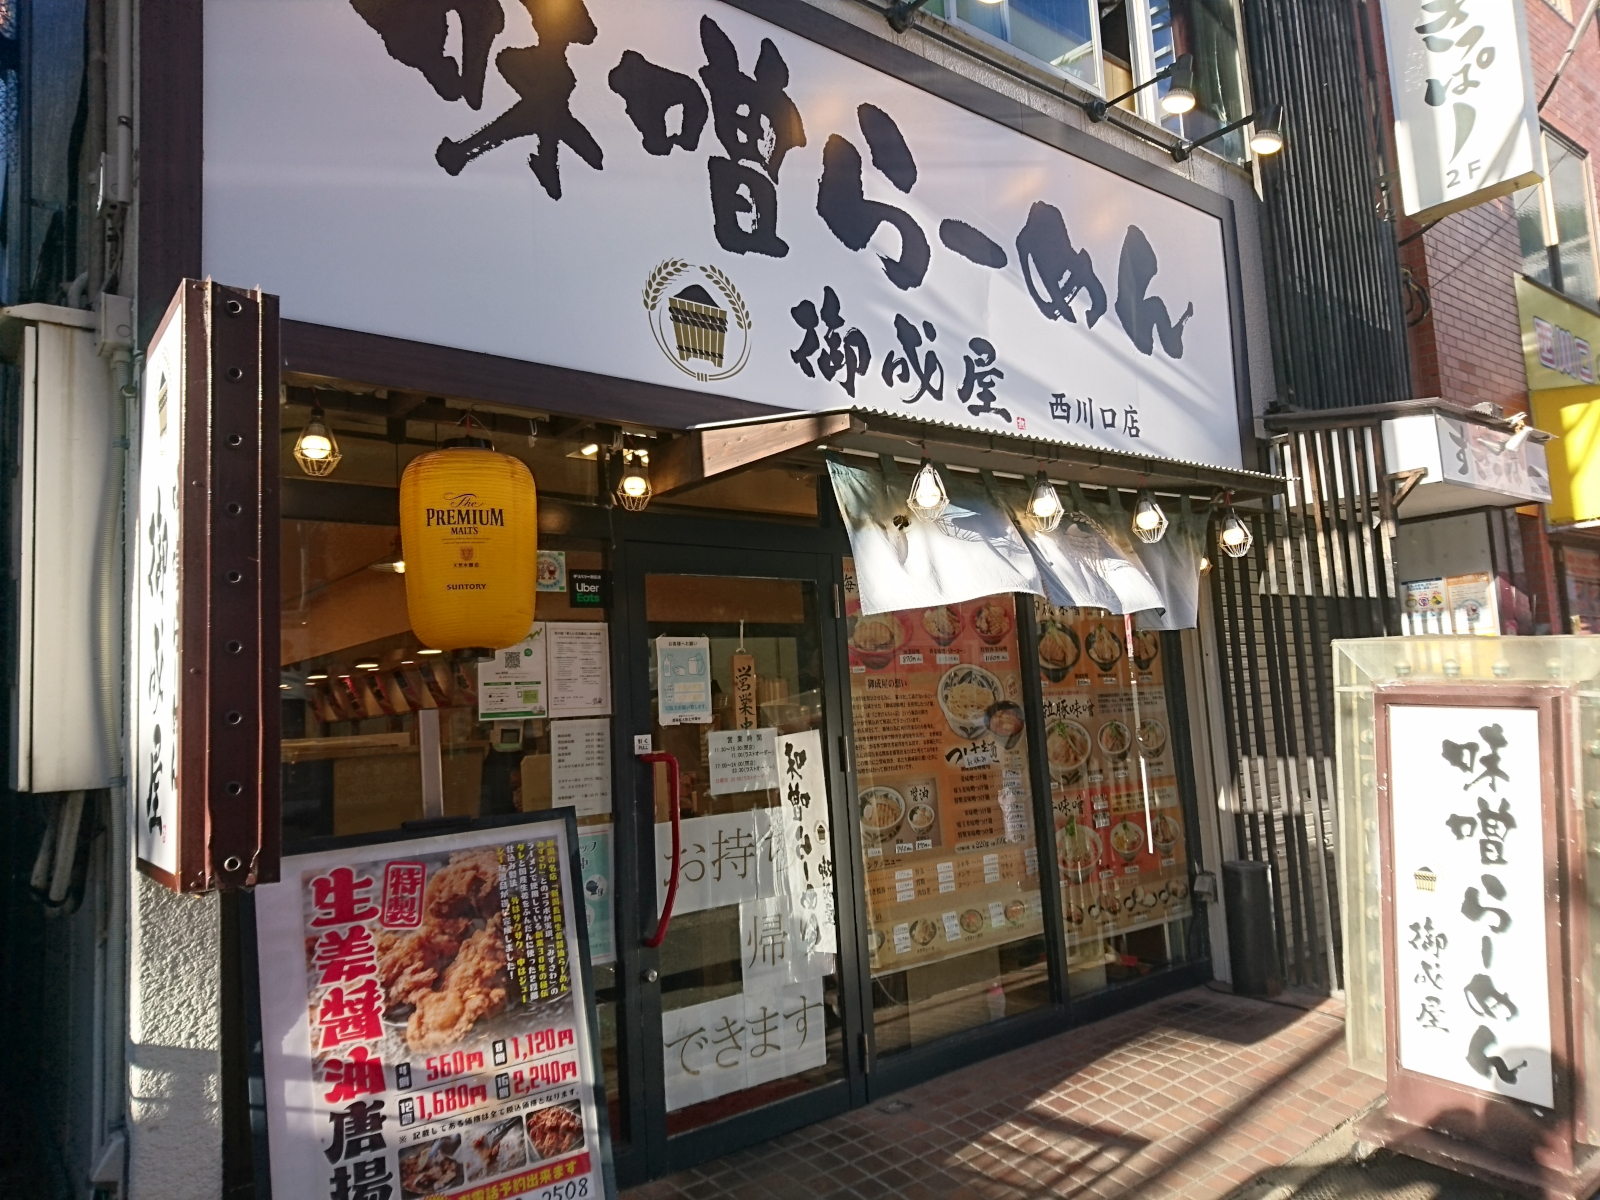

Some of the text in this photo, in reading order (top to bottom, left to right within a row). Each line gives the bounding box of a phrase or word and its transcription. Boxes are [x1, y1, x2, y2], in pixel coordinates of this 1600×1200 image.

[350, 0, 1193, 359] 味噌らーめん
[1446, 159, 1481, 188] 2F
[789, 285, 1012, 423] 御成屋
[1049, 393, 1141, 438] 西川口店
[444, 492, 485, 508] The
[426, 508, 504, 527] PREMIUM
[451, 525, 479, 535] MALT'S
[576, 582, 600, 593] Uber
[576, 593, 600, 602] Eats
[735, 665, 755, 731] 営業中
[867, 678, 908, 689] 御成屋の想い
[727, 734, 763, 743] 営業時間
[910, 786, 929, 801] 醤油
[387, 867, 422, 926] 特製
[1441, 723, 1528, 1085] 味噌らーめん
[1408, 916, 1449, 1033] 御成屋
[511, 1028, 574, 1061] 1,120円
[664, 995, 825, 1076] できます
[425, 1051, 484, 1082] 560円
[513, 1060, 577, 1094] 2,240円
[416, 1084, 487, 1121] 1,680円
